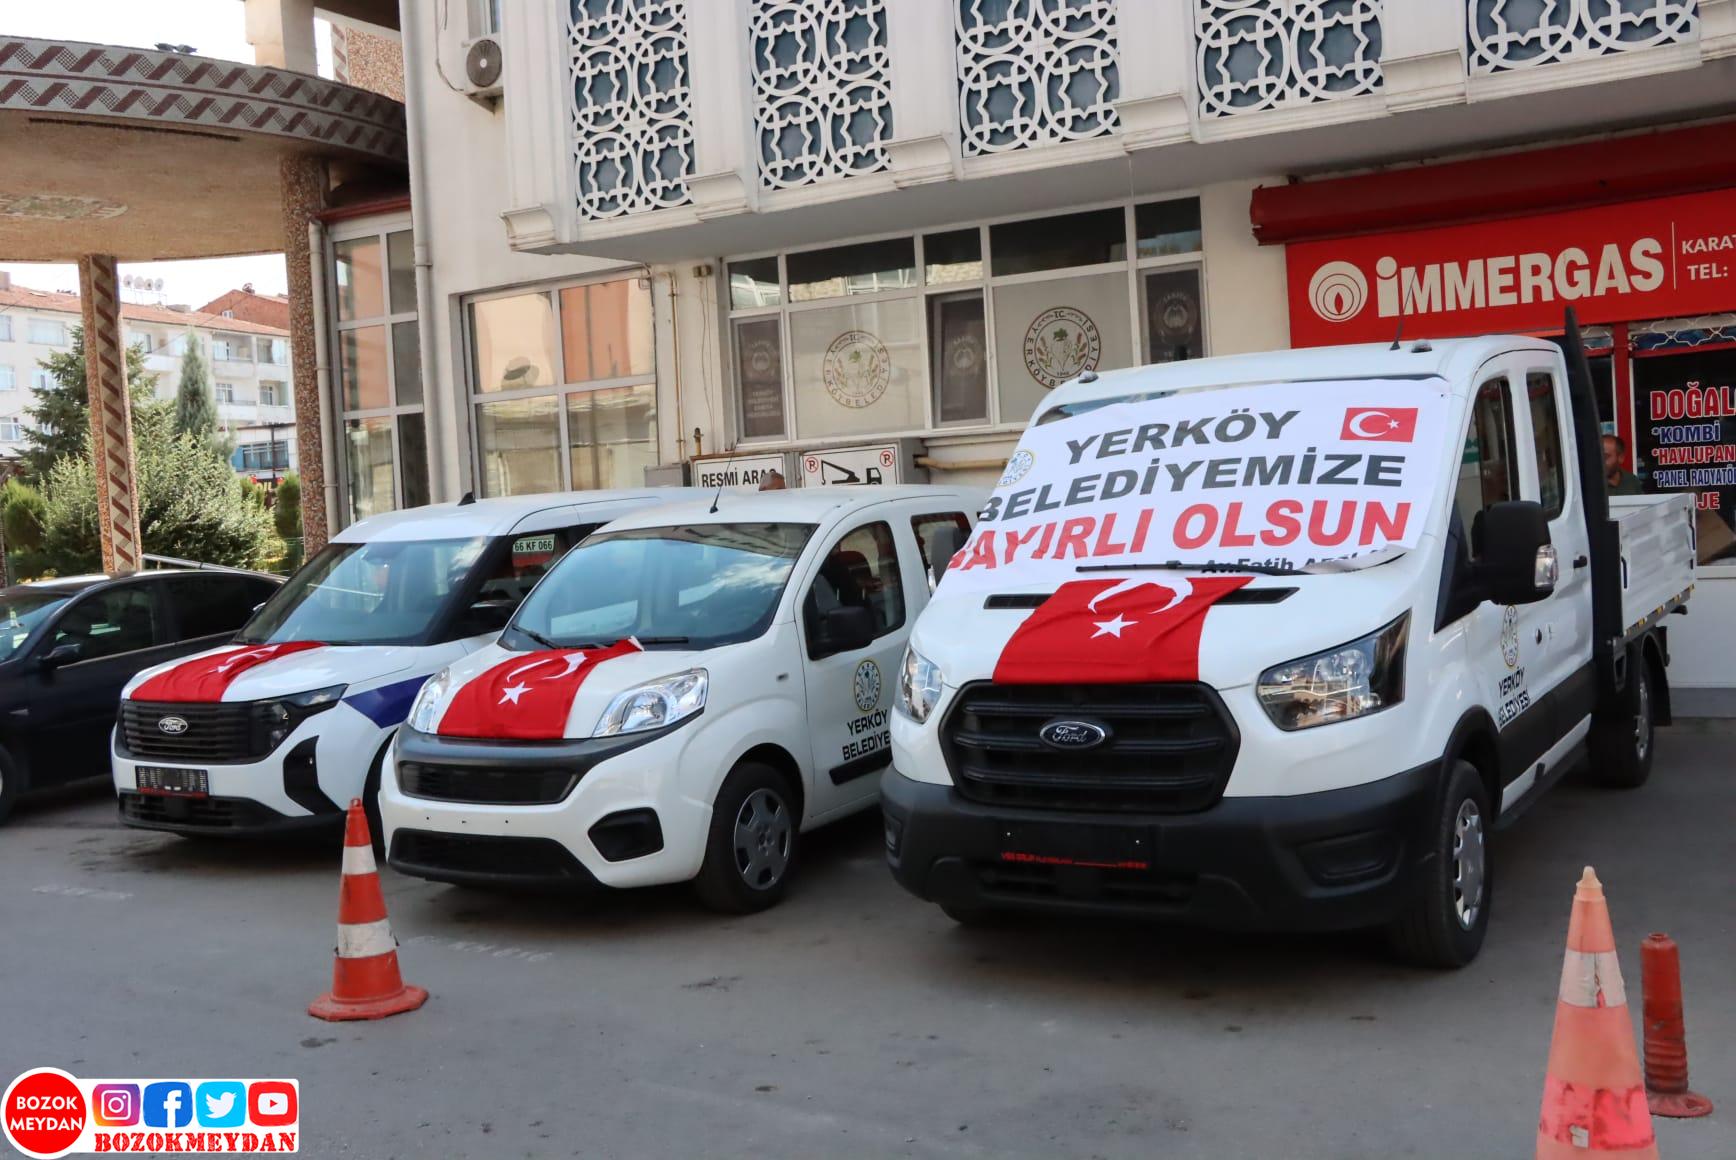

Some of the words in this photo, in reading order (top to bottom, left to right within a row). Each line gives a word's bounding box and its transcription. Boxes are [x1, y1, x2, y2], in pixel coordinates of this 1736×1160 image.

[1687, 262, 1728, 281] TEL:
[1650, 381, 1736, 420] DOĞAL
[1066, 408, 1301, 465] YERKÖY
[702, 467, 738, 488] RESMİ
[743, 469, 777, 486] ARA
[979, 447, 1405, 522] BELEDİYEMİZE
[1657, 470, 1689, 488] PANEL
[1694, 491, 1720, 510] JE
[1173, 500, 1411, 554] OLSUN
[847, 708, 888, 736] YERKÖY
[1052, 725, 1088, 743] Ford
